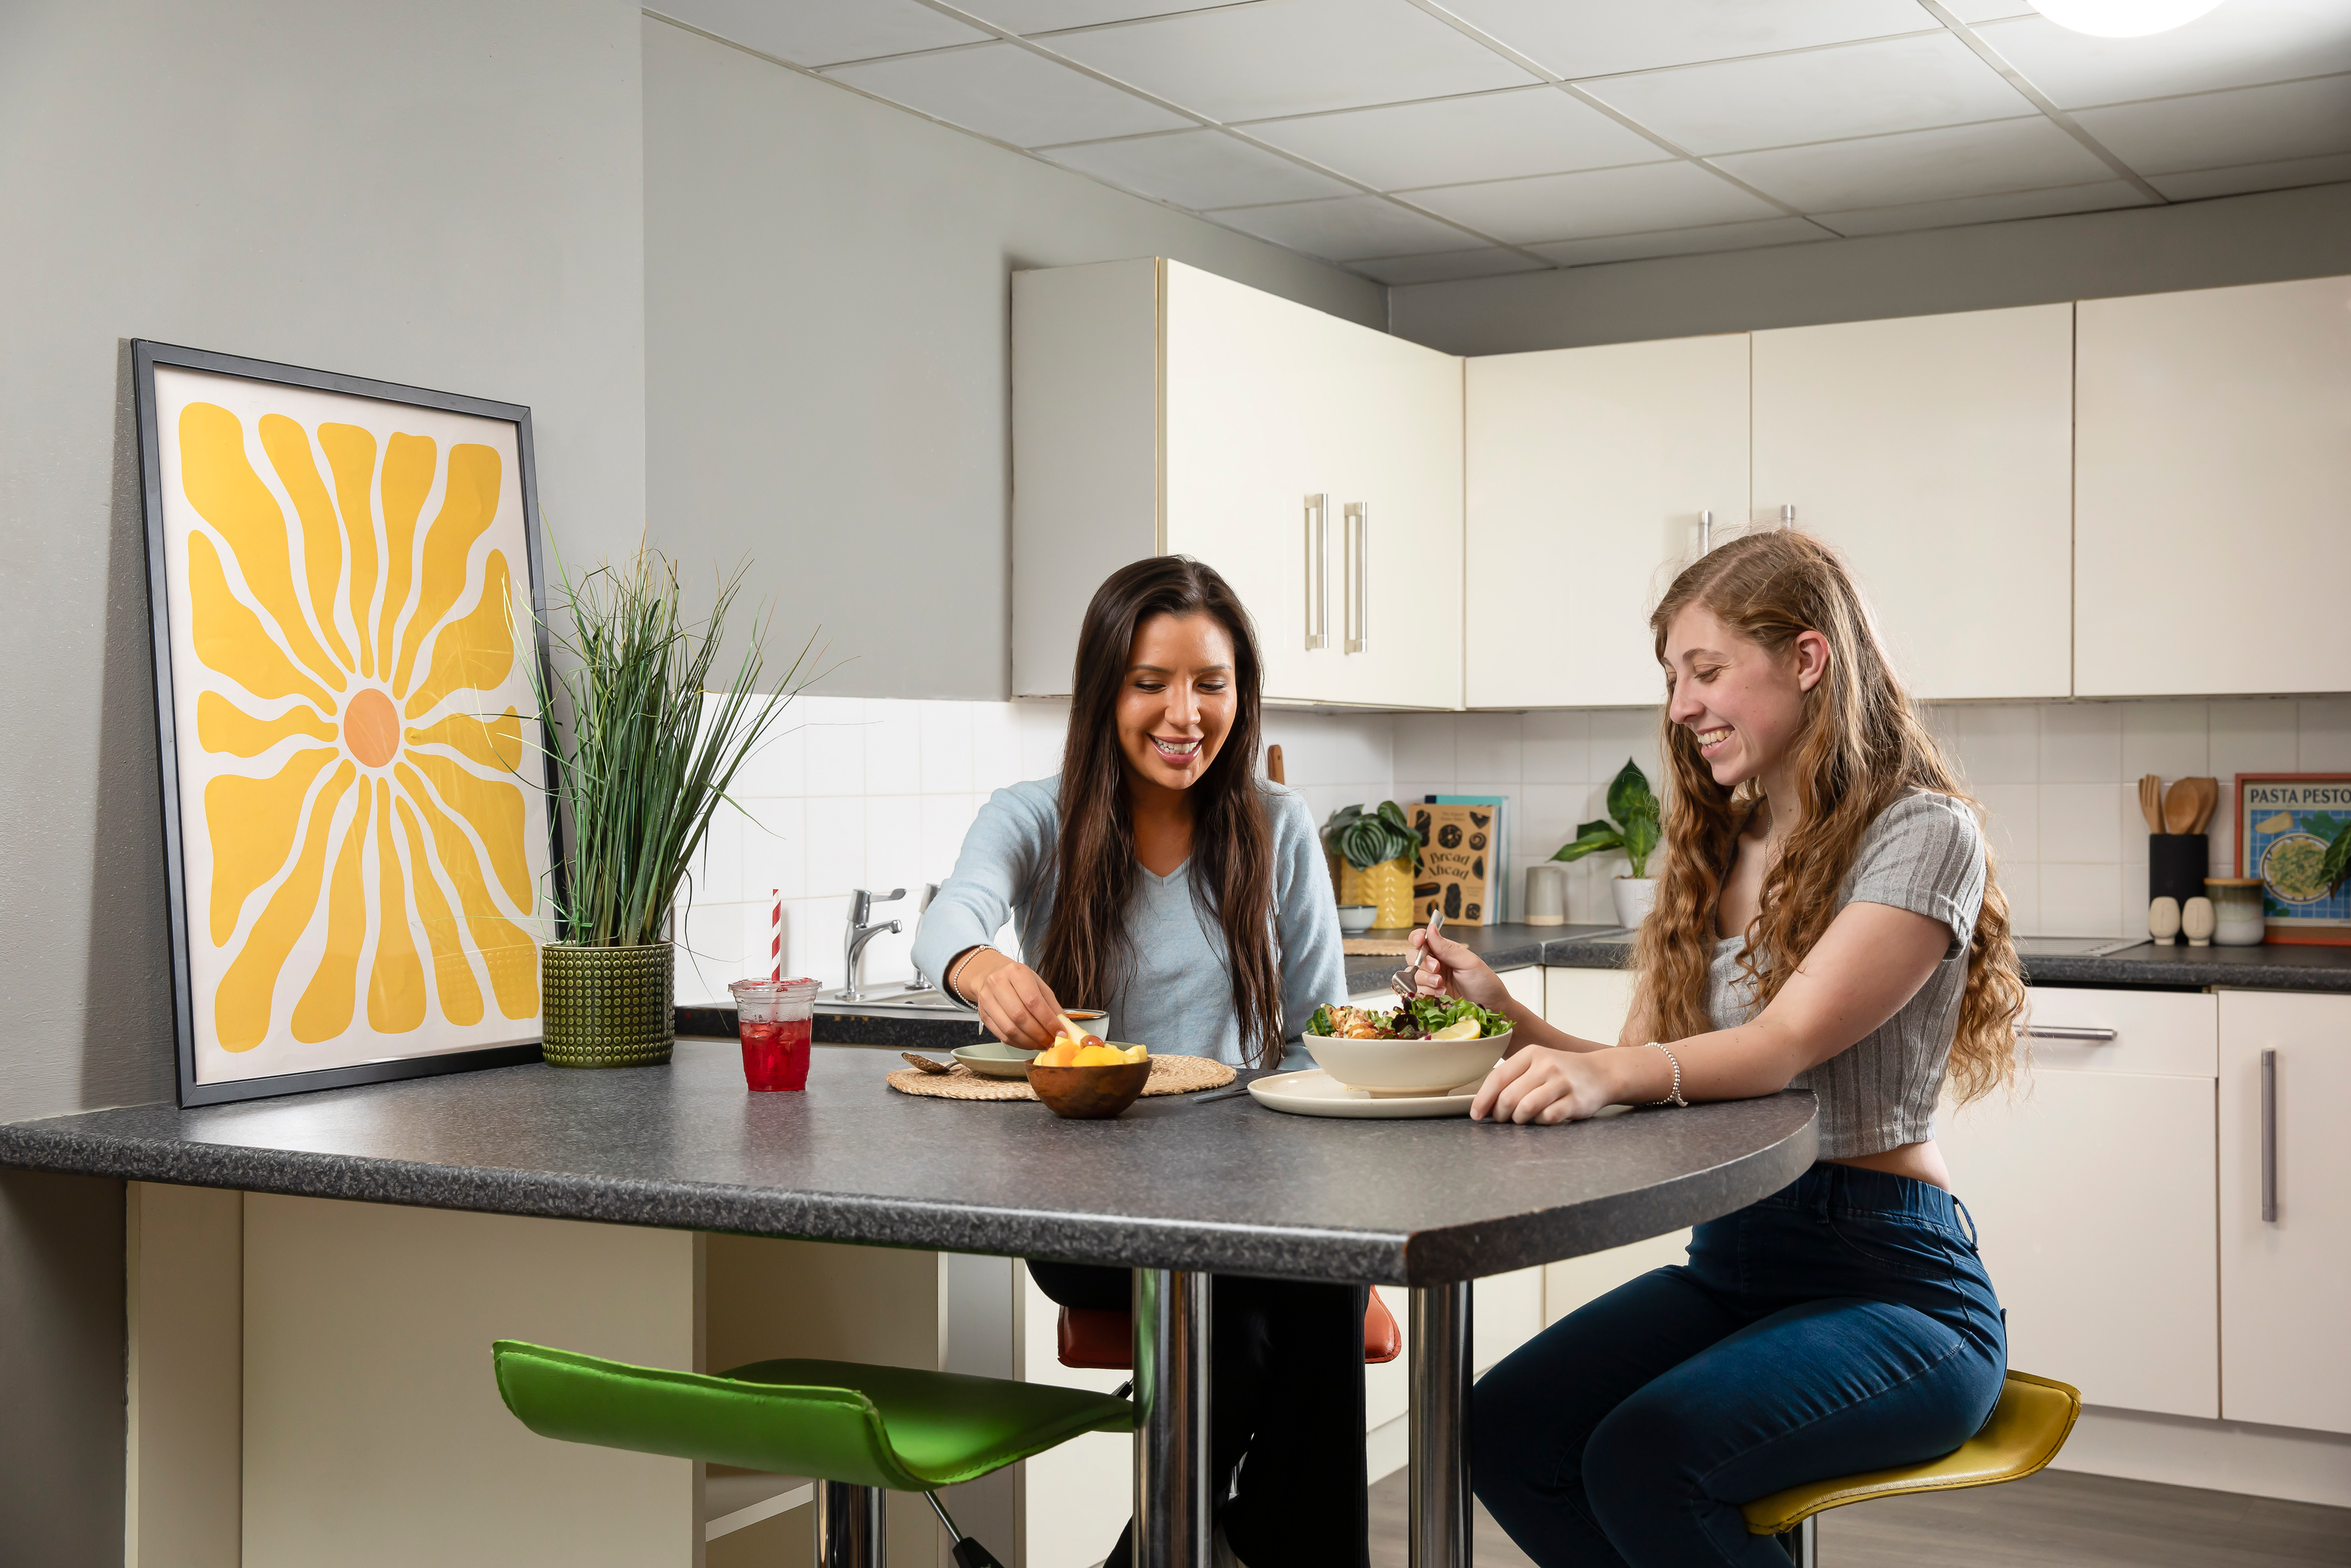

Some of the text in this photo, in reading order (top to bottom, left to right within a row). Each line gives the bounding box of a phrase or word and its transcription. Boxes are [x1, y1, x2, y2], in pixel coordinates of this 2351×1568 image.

[2251, 788, 2351, 804] PASTA PESTO
[1430, 852, 1470, 866] Bread
[1429, 864, 1469, 880] Ahead
